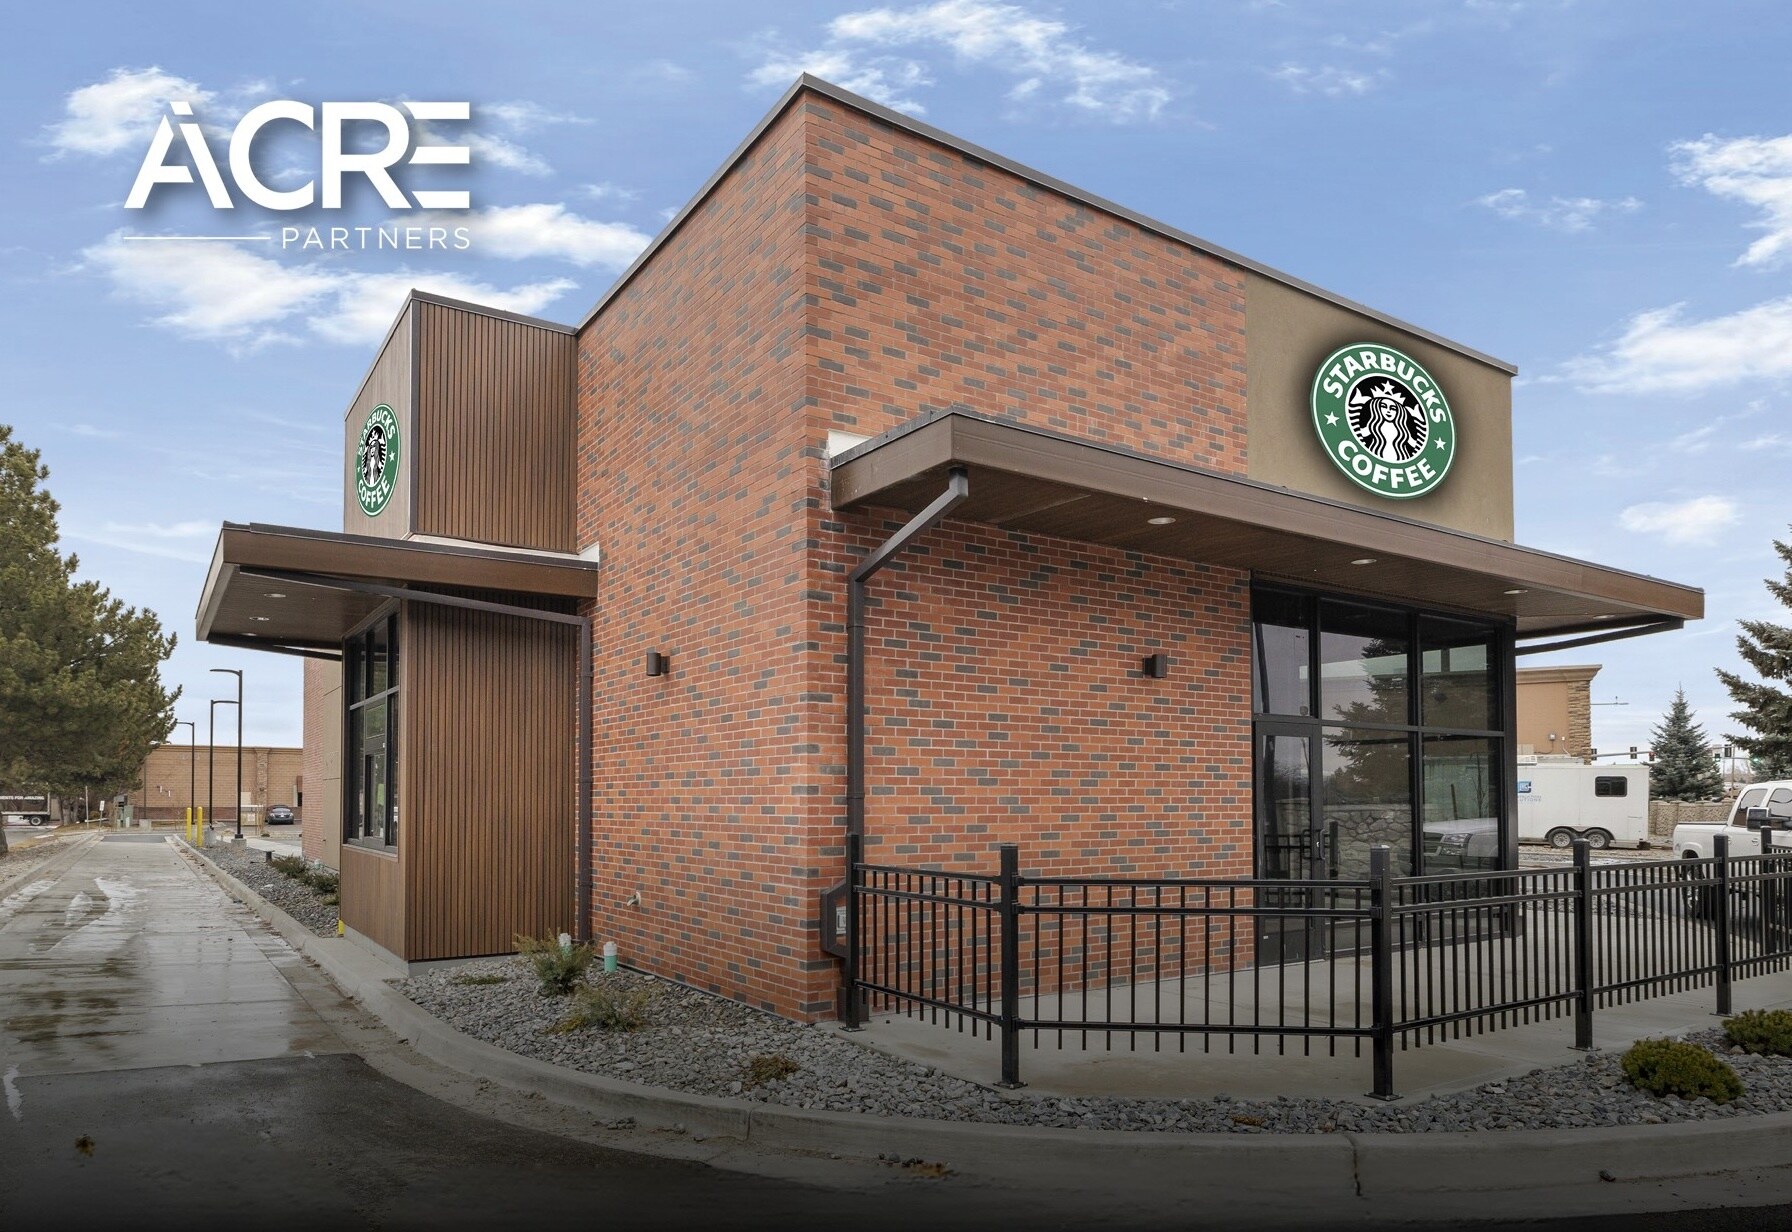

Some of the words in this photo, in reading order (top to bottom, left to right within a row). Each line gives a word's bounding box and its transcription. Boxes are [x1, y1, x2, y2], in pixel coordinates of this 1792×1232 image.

[1323, 351, 1447, 424] STARBUCKS
[1338, 440, 1437, 489] COFFEE
[358, 475, 390, 508] COFFEE
